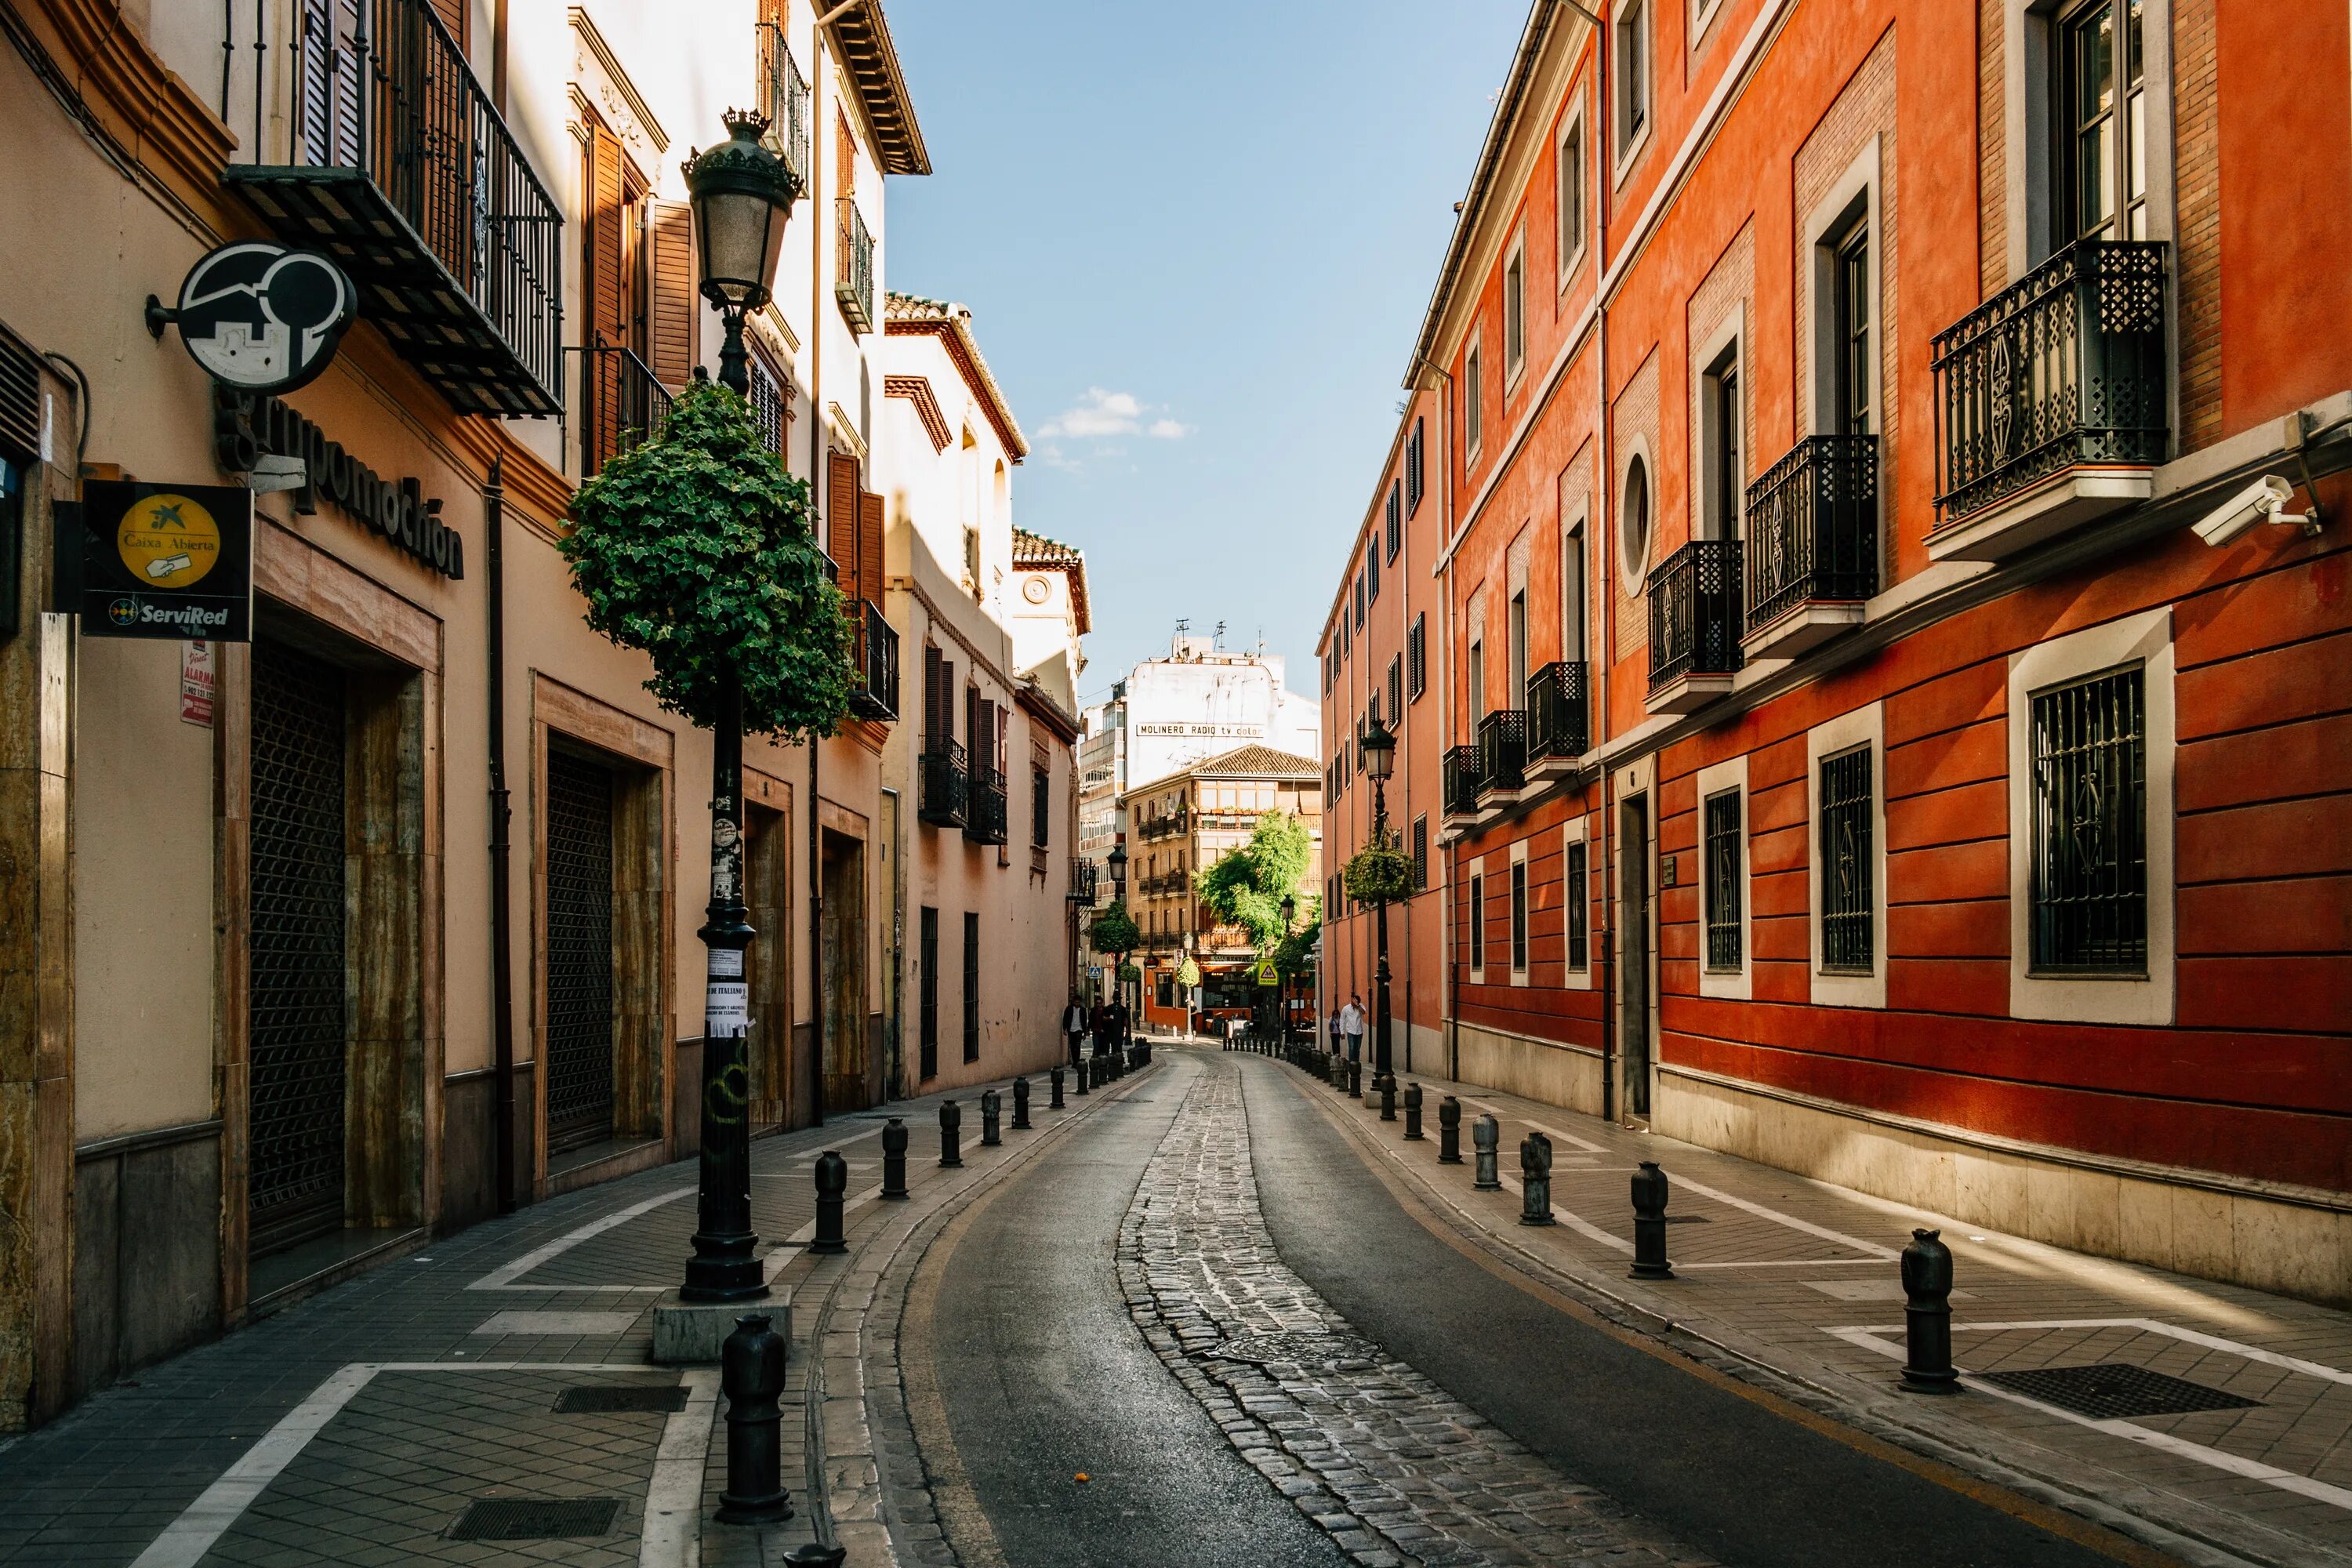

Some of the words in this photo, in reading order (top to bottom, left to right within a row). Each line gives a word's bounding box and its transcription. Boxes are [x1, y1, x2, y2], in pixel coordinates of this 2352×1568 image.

[124, 533, 162, 548] Caixa
[169, 537, 214, 550] Abierta
[141, 604, 228, 626] ServiRed
[184, 666, 214, 685] ALARMA
[1141, 725, 1184, 734] MOLINERO
[1192, 726, 1215, 735] RADIO
[1630, 771, 1635, 788] 6
